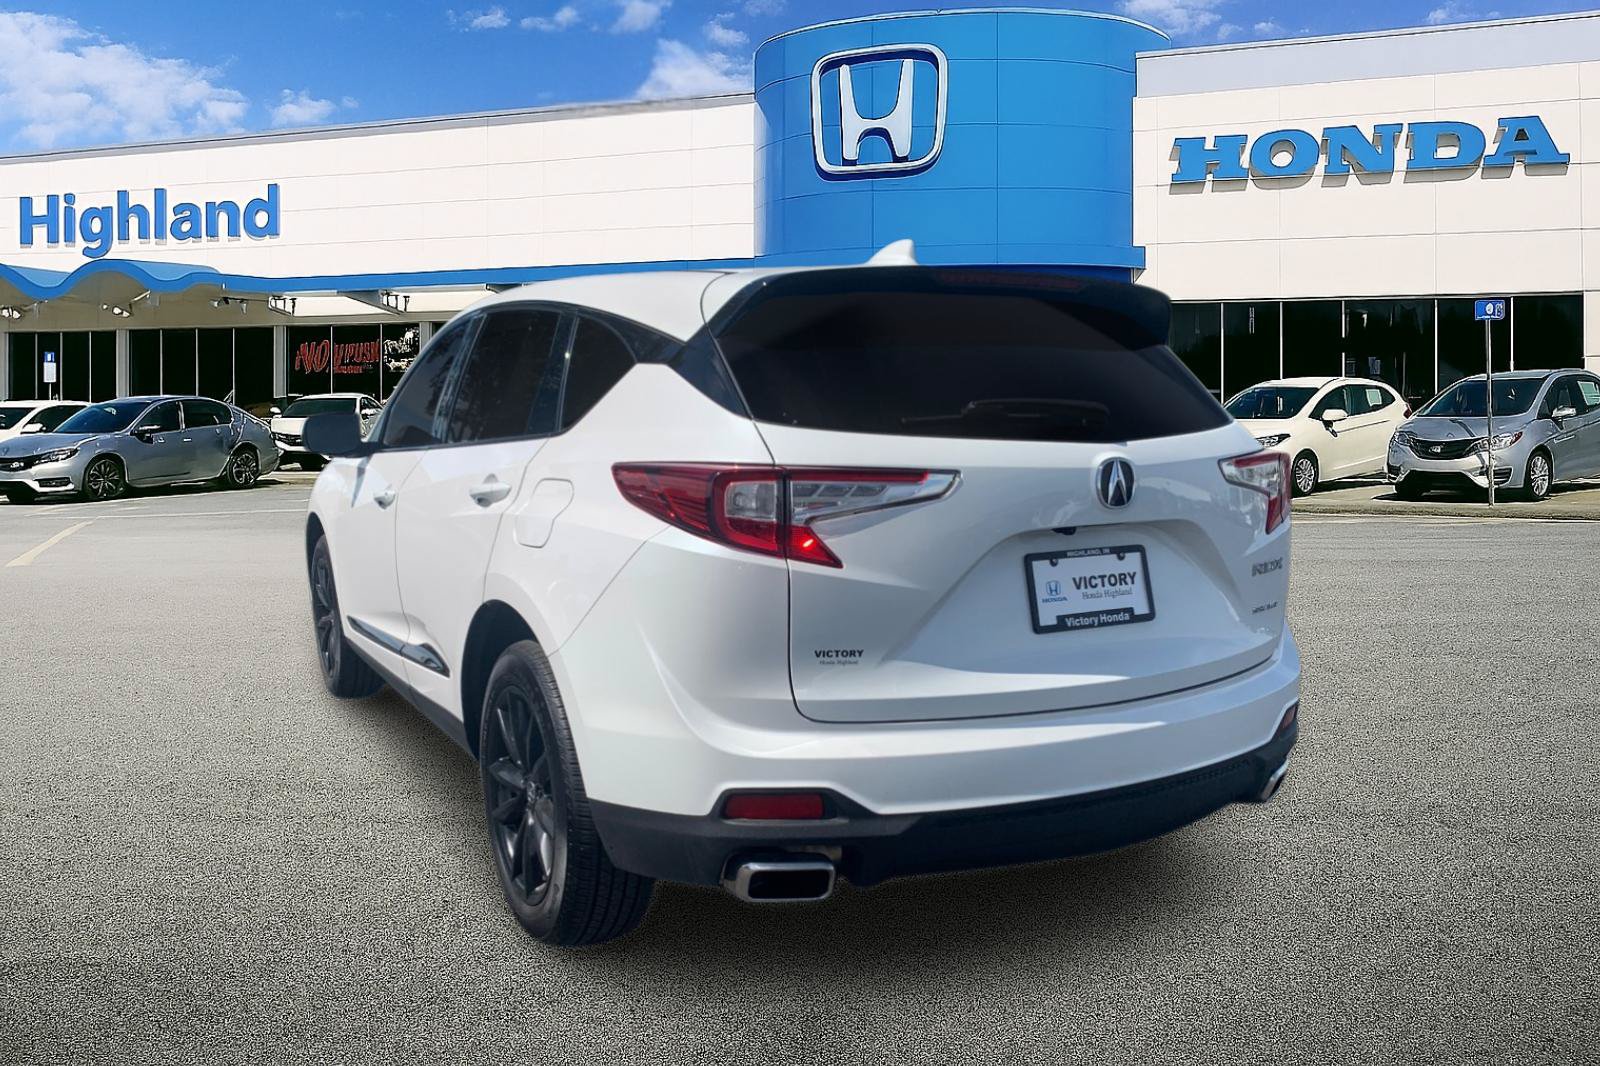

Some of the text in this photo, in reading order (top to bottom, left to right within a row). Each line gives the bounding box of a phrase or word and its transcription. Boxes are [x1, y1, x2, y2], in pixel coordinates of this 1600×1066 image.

[1171, 115, 1570, 184] HONDA
[19, 183, 280, 259] Highland
[1072, 571, 1137, 590] VICTORY
[1082, 587, 1133, 600] Honda Highland
[1064, 611, 1130, 628] Victory Honda
[814, 649, 864, 659] VICTORY
